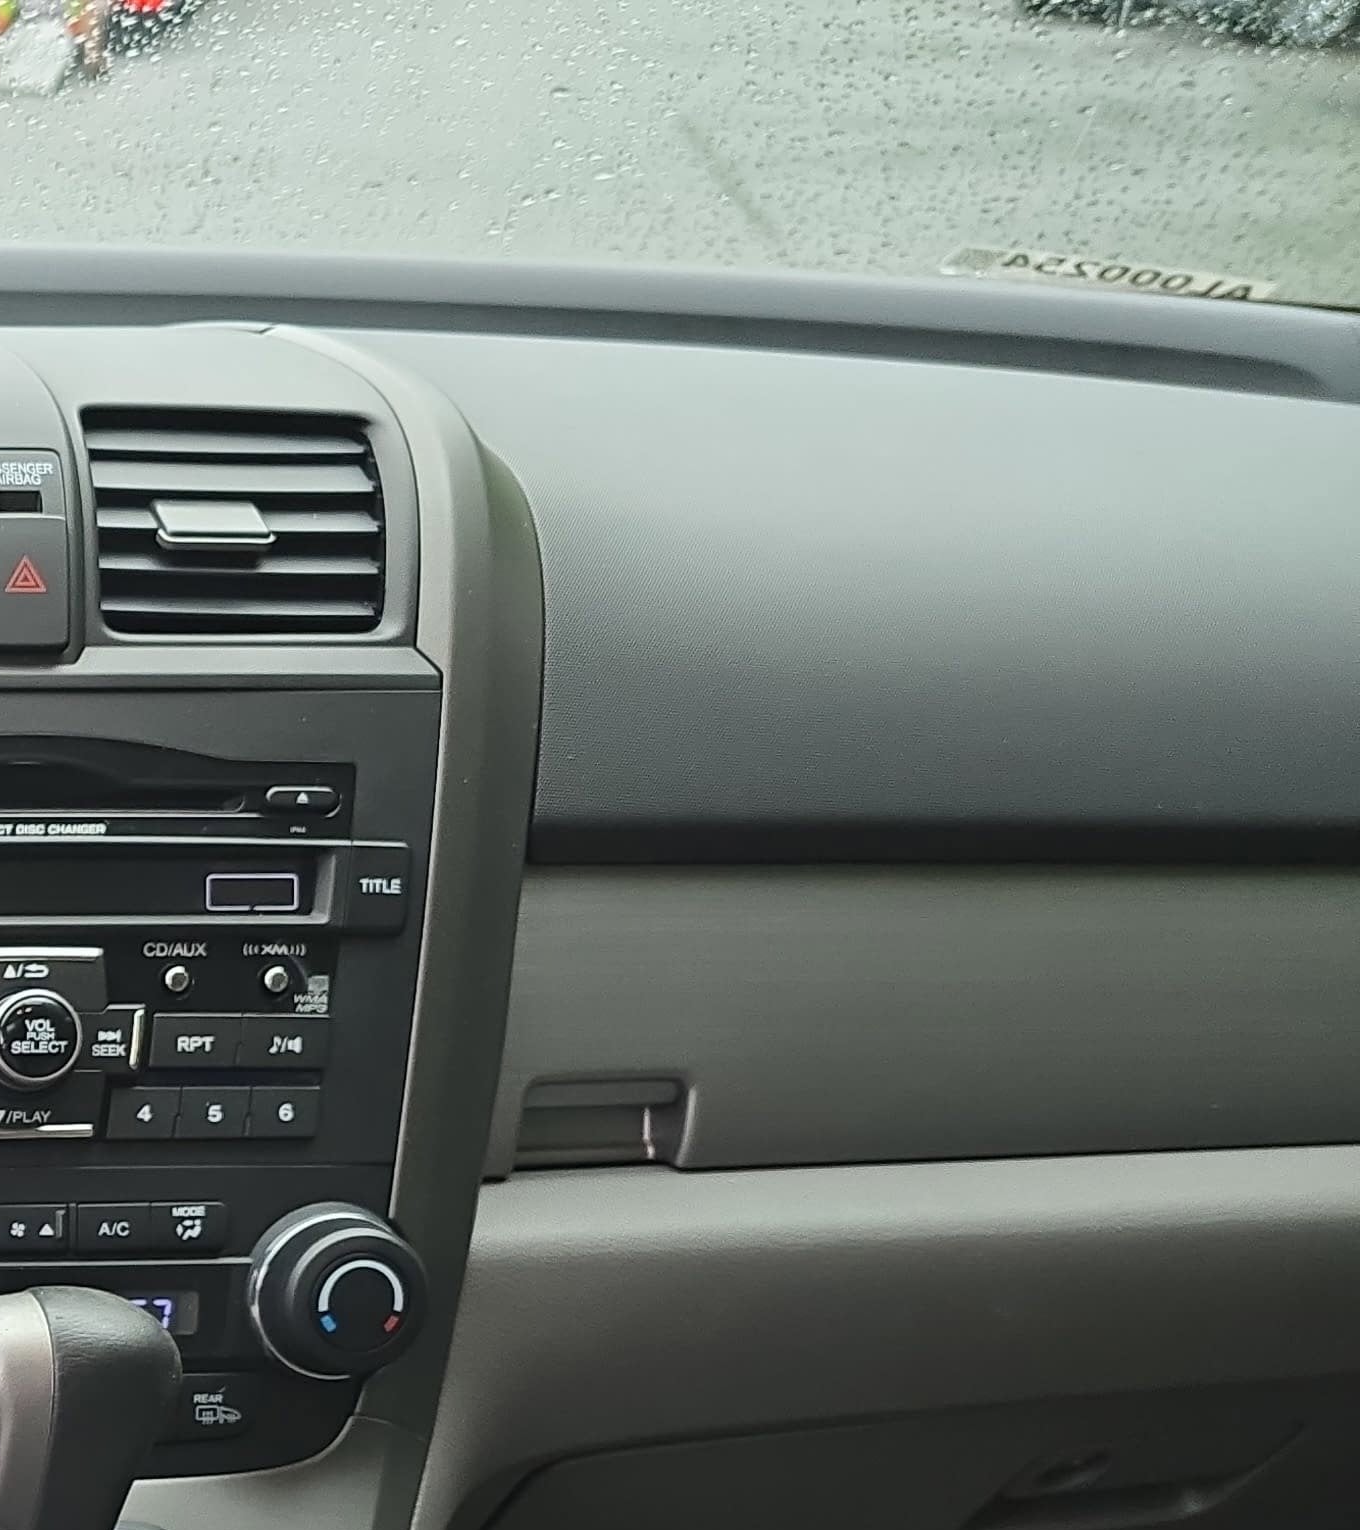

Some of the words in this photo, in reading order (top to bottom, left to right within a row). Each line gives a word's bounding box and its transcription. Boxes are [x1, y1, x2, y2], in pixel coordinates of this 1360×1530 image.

[15, 824, 46, 836] DISC
[47, 823, 107, 835] CHANGER
[359, 878, 401, 894] TITLE
[143, 943, 207, 957] CD/AUX
[24, 1019, 55, 1032] VOL
[26, 1031, 55, 1041] PUSH
[10, 1041, 69, 1054] SELECT
[91, 1044, 127, 1057] SEEK
[177, 1036, 215, 1052] RPT
[136, 1104, 153, 1123] 4
[207, 1104, 224, 1123] 5
[278, 1103, 295, 1122] 6
[171, 1206, 206, 1217] MODE
[98, 1221, 130, 1237] A/C
[193, 1393, 223, 1404] REAR
